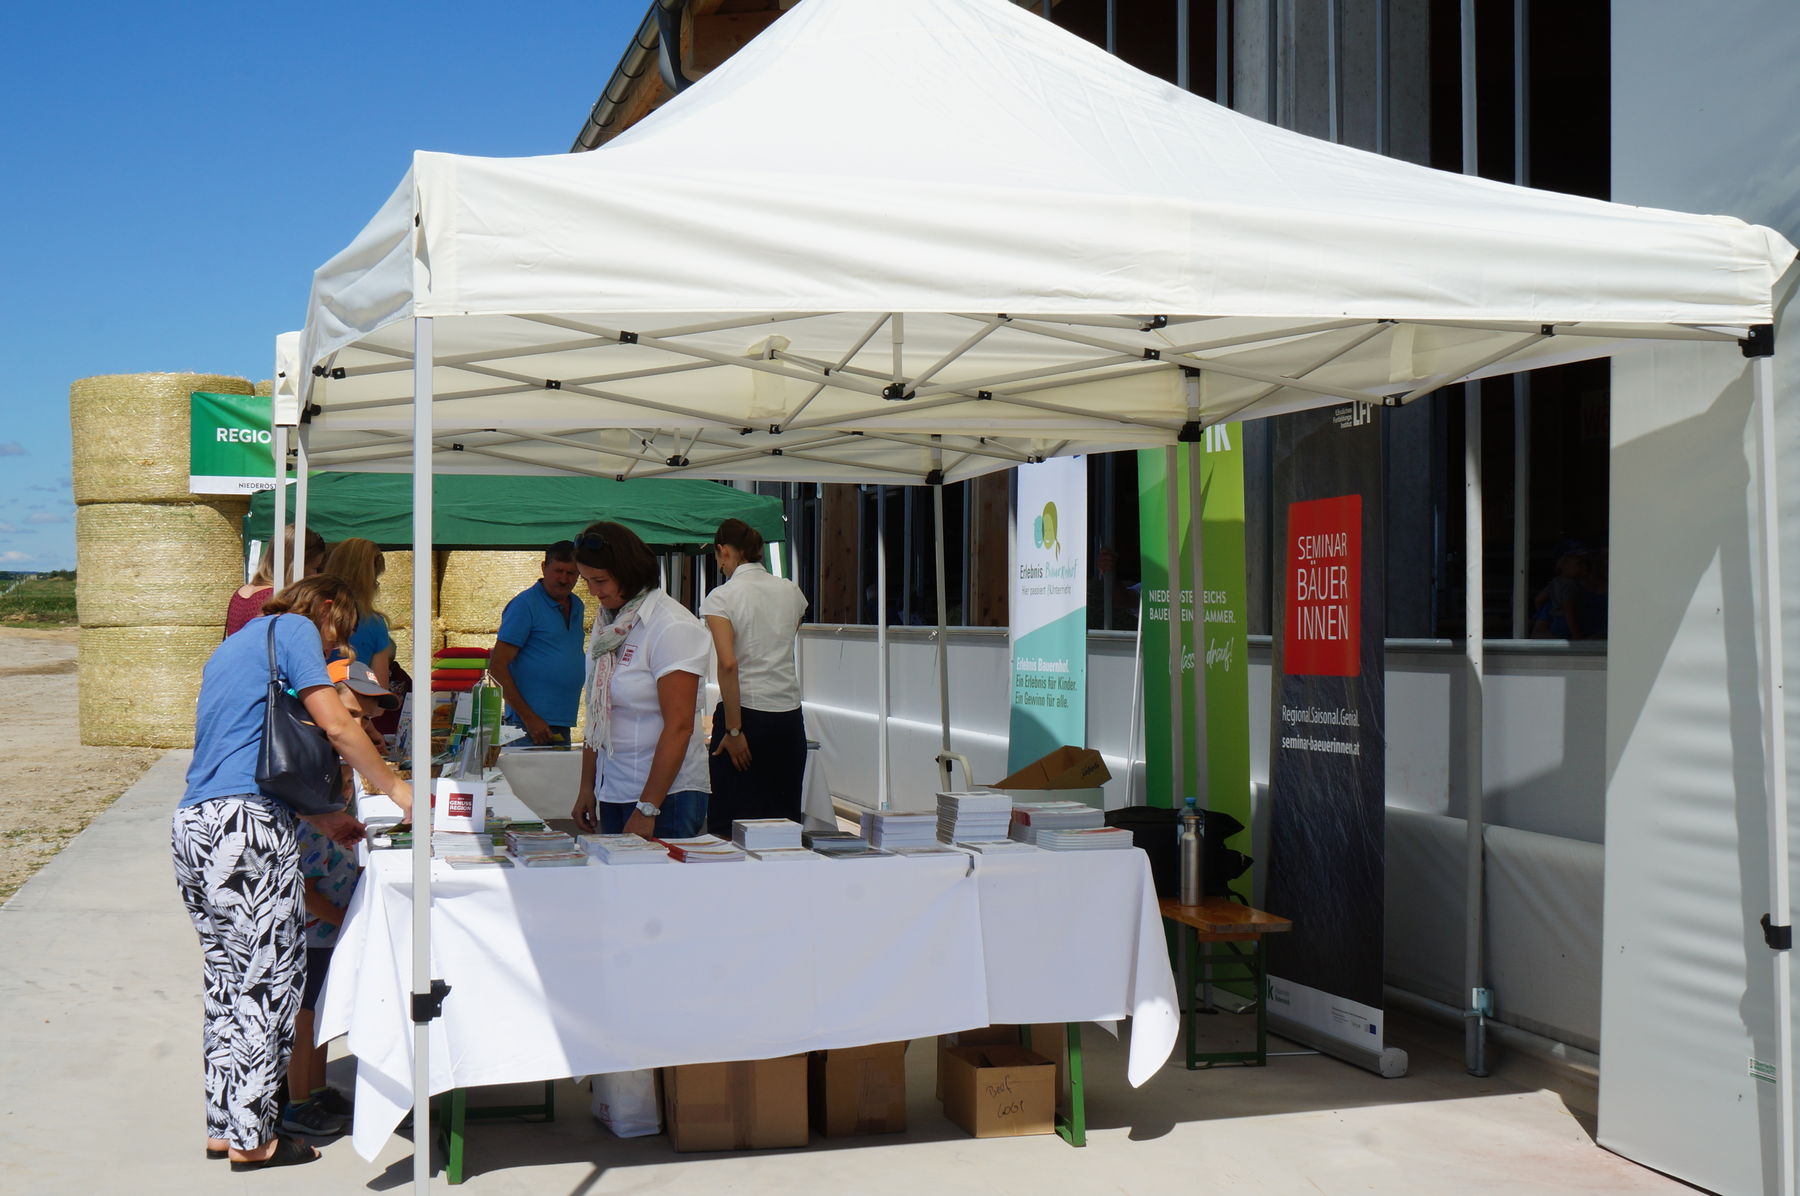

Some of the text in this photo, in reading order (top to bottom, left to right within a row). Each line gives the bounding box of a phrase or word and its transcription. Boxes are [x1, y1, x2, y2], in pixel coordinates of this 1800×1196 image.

[216, 427, 272, 444] REGIO
[1297, 532, 1348, 560] SEMINAR
[1020, 563, 1043, 579] Erlebnis
[1297, 559, 1348, 601] BÄUER
[1202, 610, 1236, 624] AMMER.
[1297, 605, 1349, 641] INNEN
[1016, 657, 1037, 671] Erlebnis
[1015, 673, 1024, 688] Ein
[1024, 674, 1047, 690] Erlebnis
[1047, 675, 1057, 690] für
[1015, 691, 1023, 704] Ein
[1023, 691, 1046, 707] Gewinn
[1046, 693, 1055, 708] für
[1281, 733, 1360, 756] seminar-baeuerinnen.at
